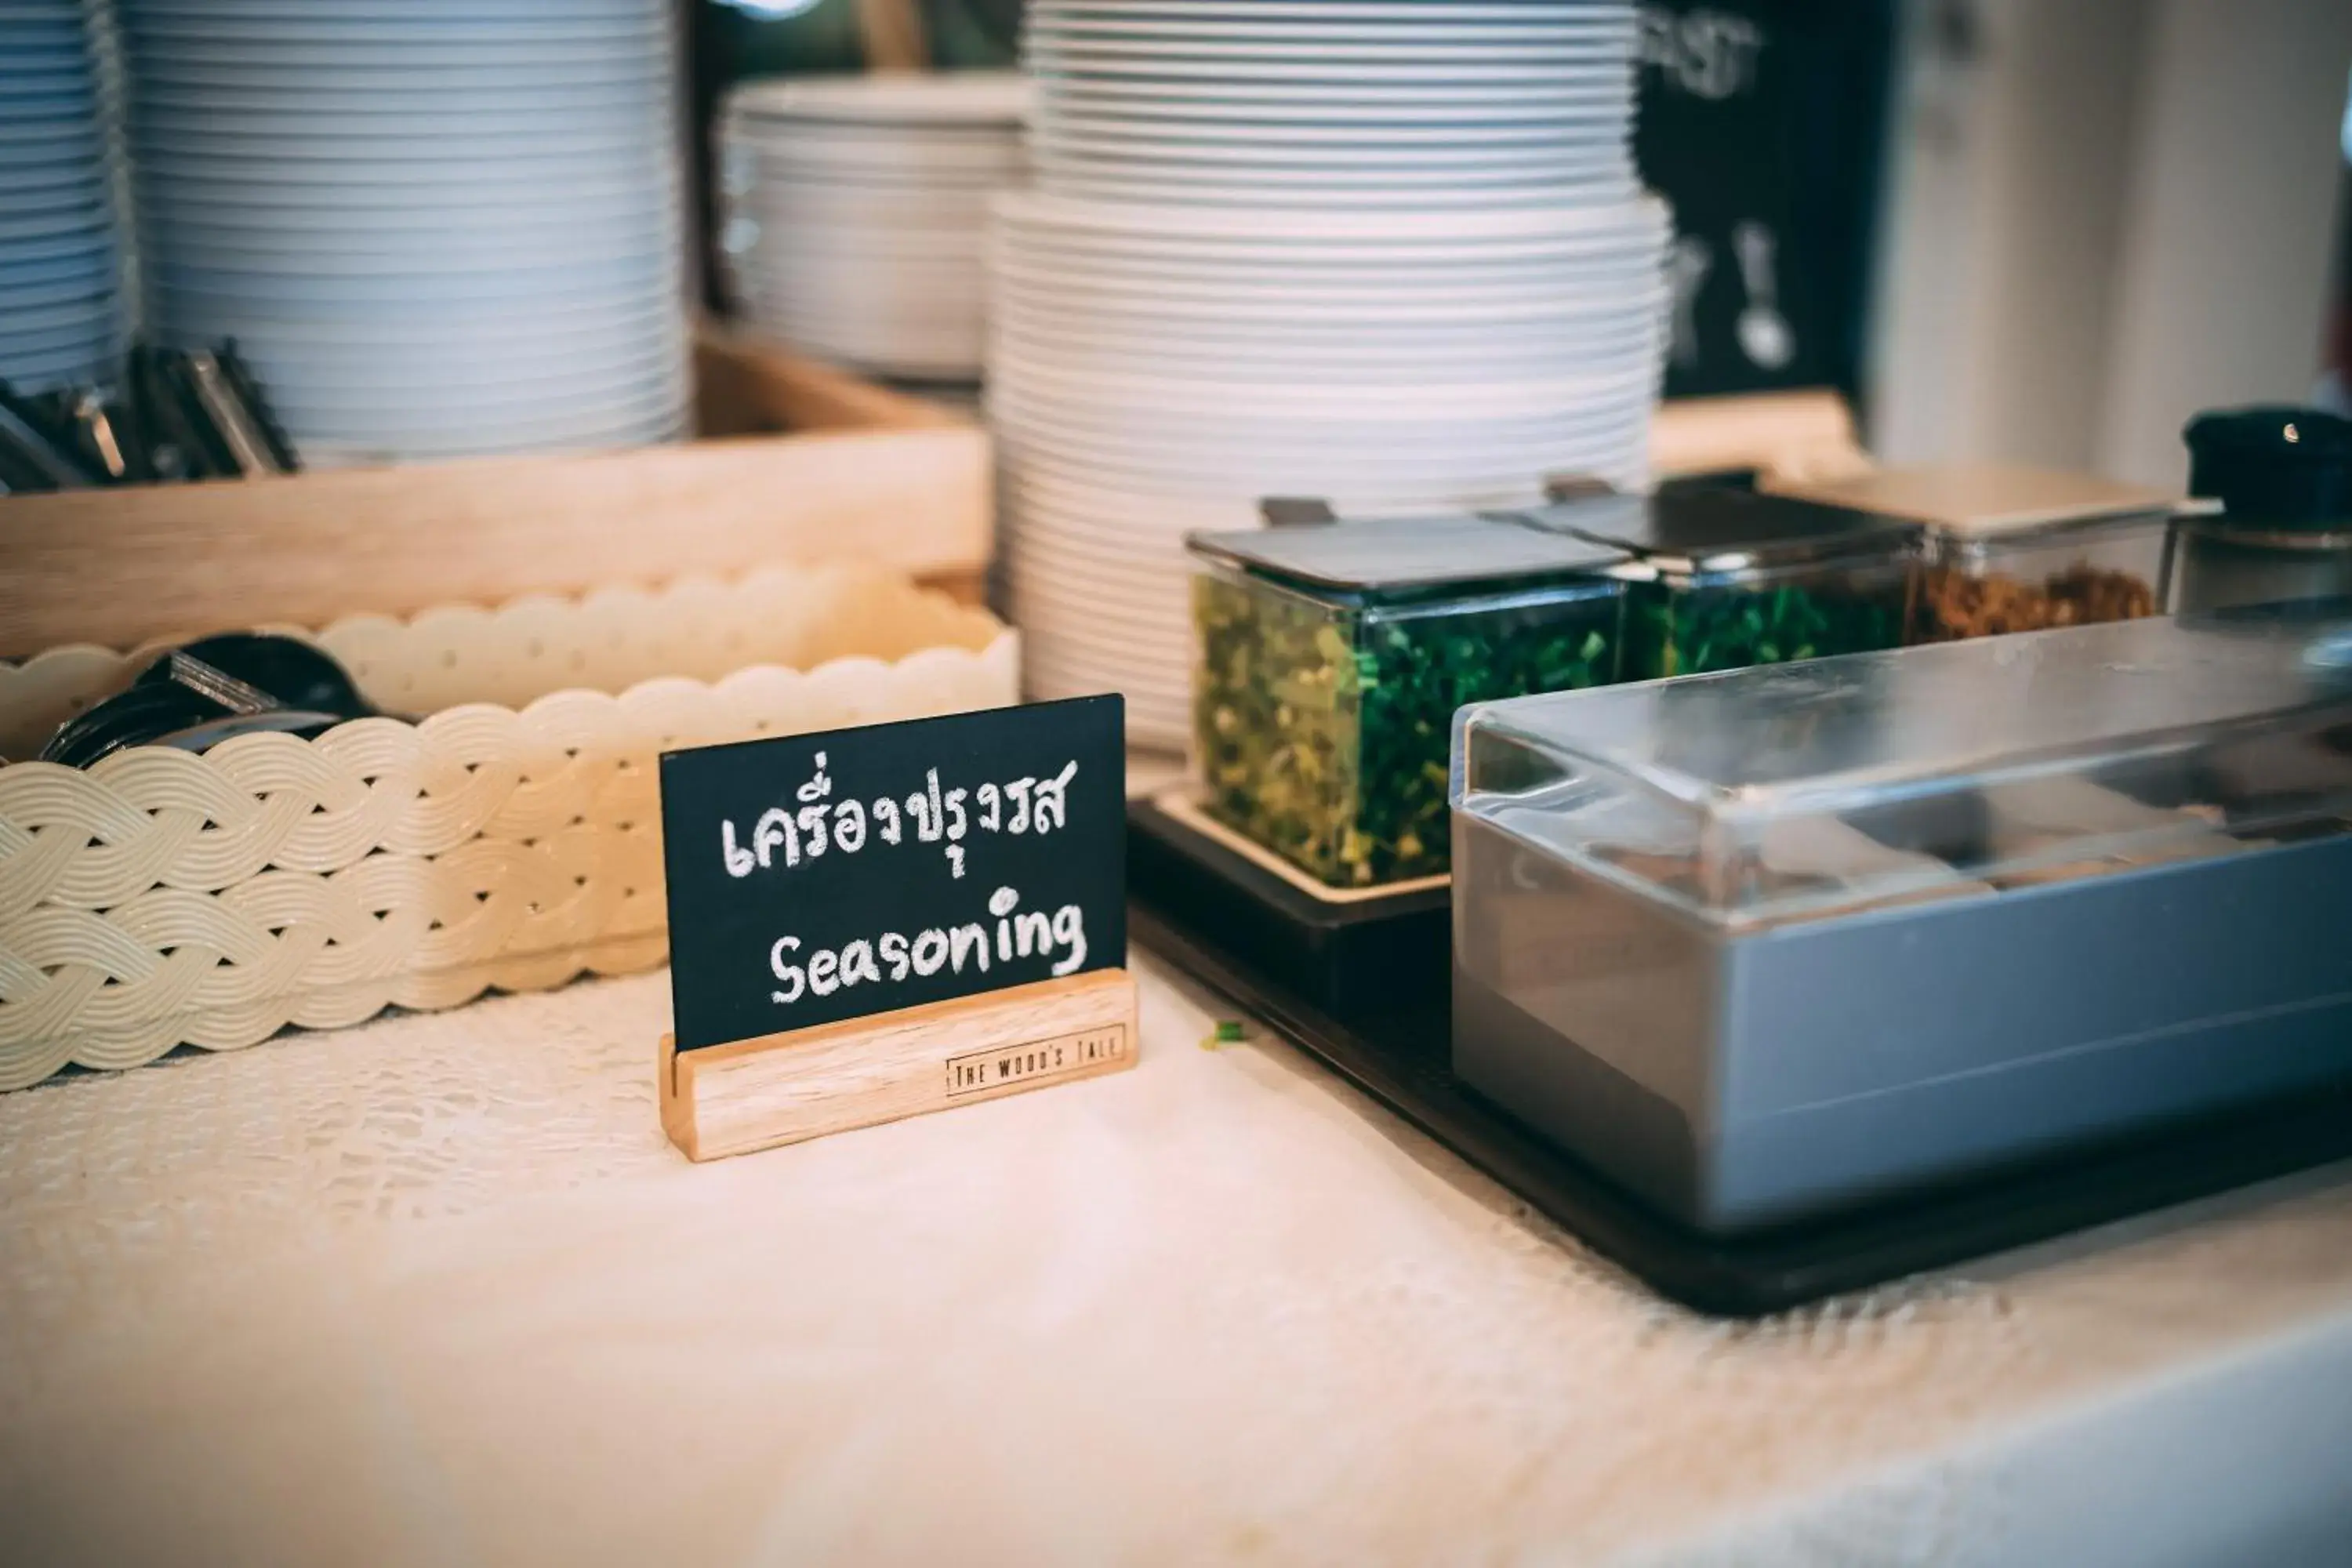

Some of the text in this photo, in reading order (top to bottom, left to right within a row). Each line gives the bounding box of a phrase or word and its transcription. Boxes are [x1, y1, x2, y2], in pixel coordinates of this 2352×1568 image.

[721, 751, 1078, 879] เครื่องปรุงรส
[770, 886, 1088, 1004] Seasoning
[956, 1064, 985, 1087] THE
[1077, 1037, 1116, 1062] TALE
